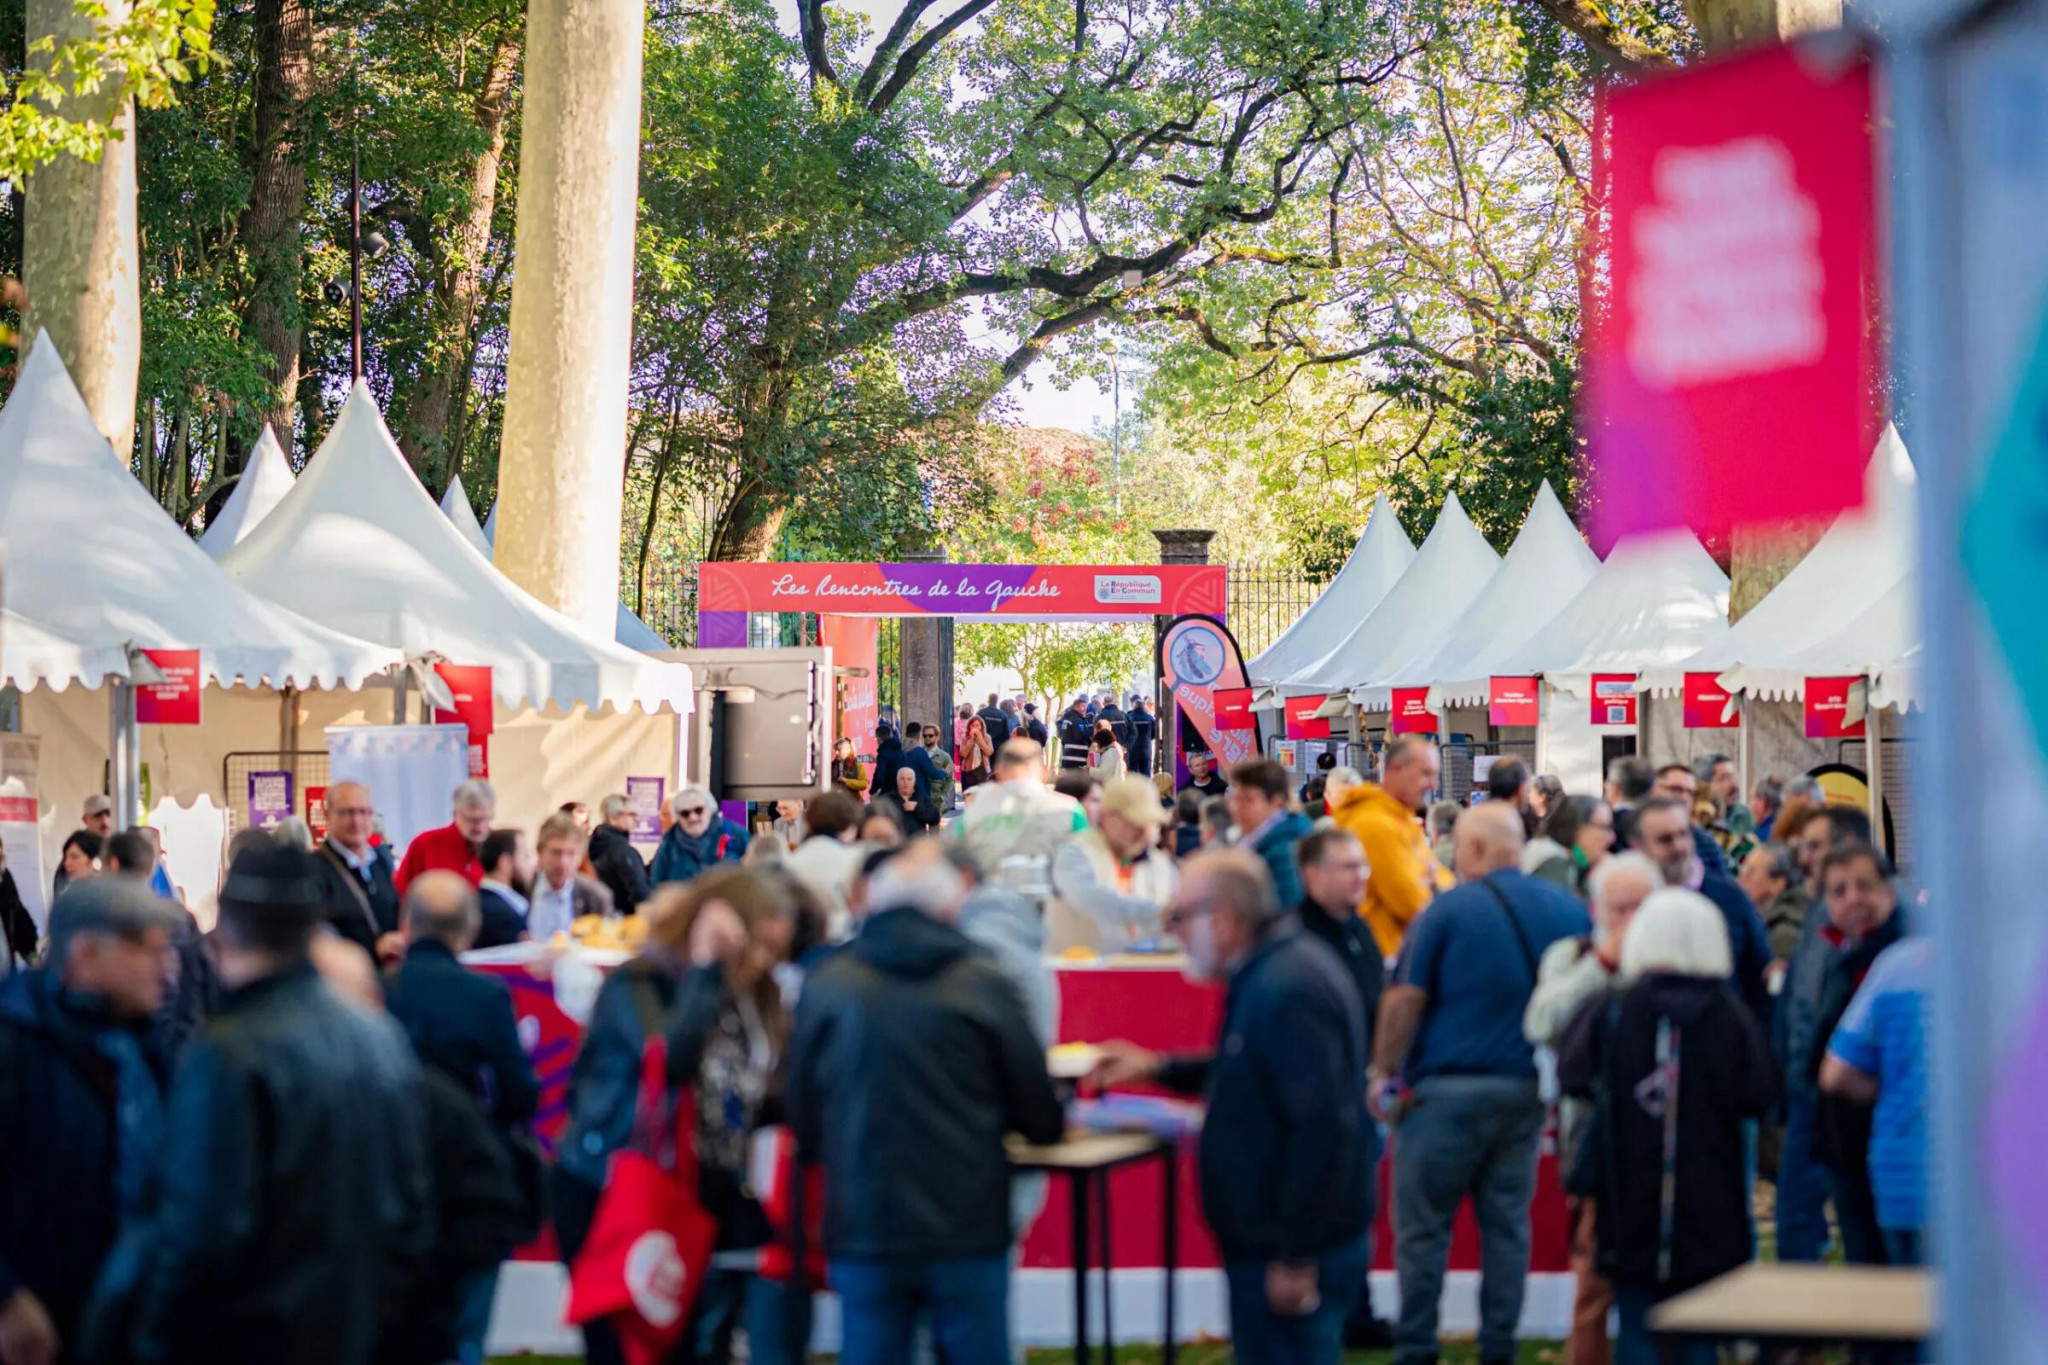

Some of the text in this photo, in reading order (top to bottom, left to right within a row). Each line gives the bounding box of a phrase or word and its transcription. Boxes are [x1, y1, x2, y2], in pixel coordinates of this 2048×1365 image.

[771, 574, 1061, 611] Les Rencontres de la Gauche
